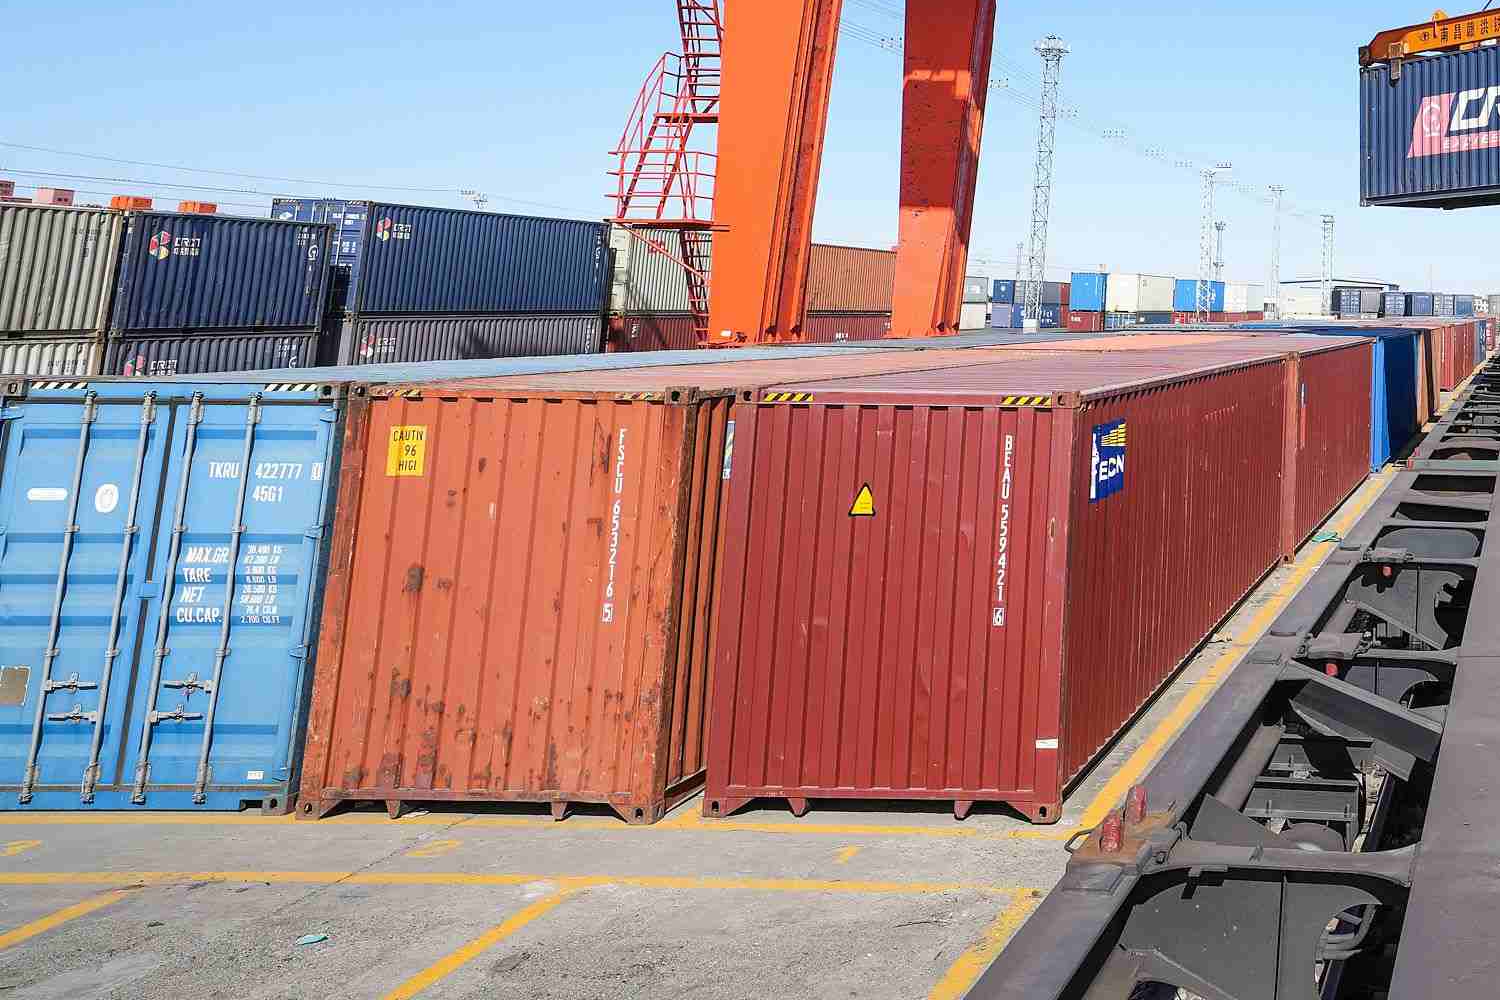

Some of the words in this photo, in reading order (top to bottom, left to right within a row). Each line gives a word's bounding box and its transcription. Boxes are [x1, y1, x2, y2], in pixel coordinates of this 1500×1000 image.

[208, 462, 240, 479] TKRU
[255, 462, 303, 480] 422777
[1001, 434, 1013, 500] BEAU
[252, 485, 283, 502] 45G1
[606, 498, 622, 598] 653216
[996, 504, 1009, 601] 559421
[182, 567, 212, 583] TARE
[179, 586, 205, 603] NET
[992, 607, 1005, 626] 6
